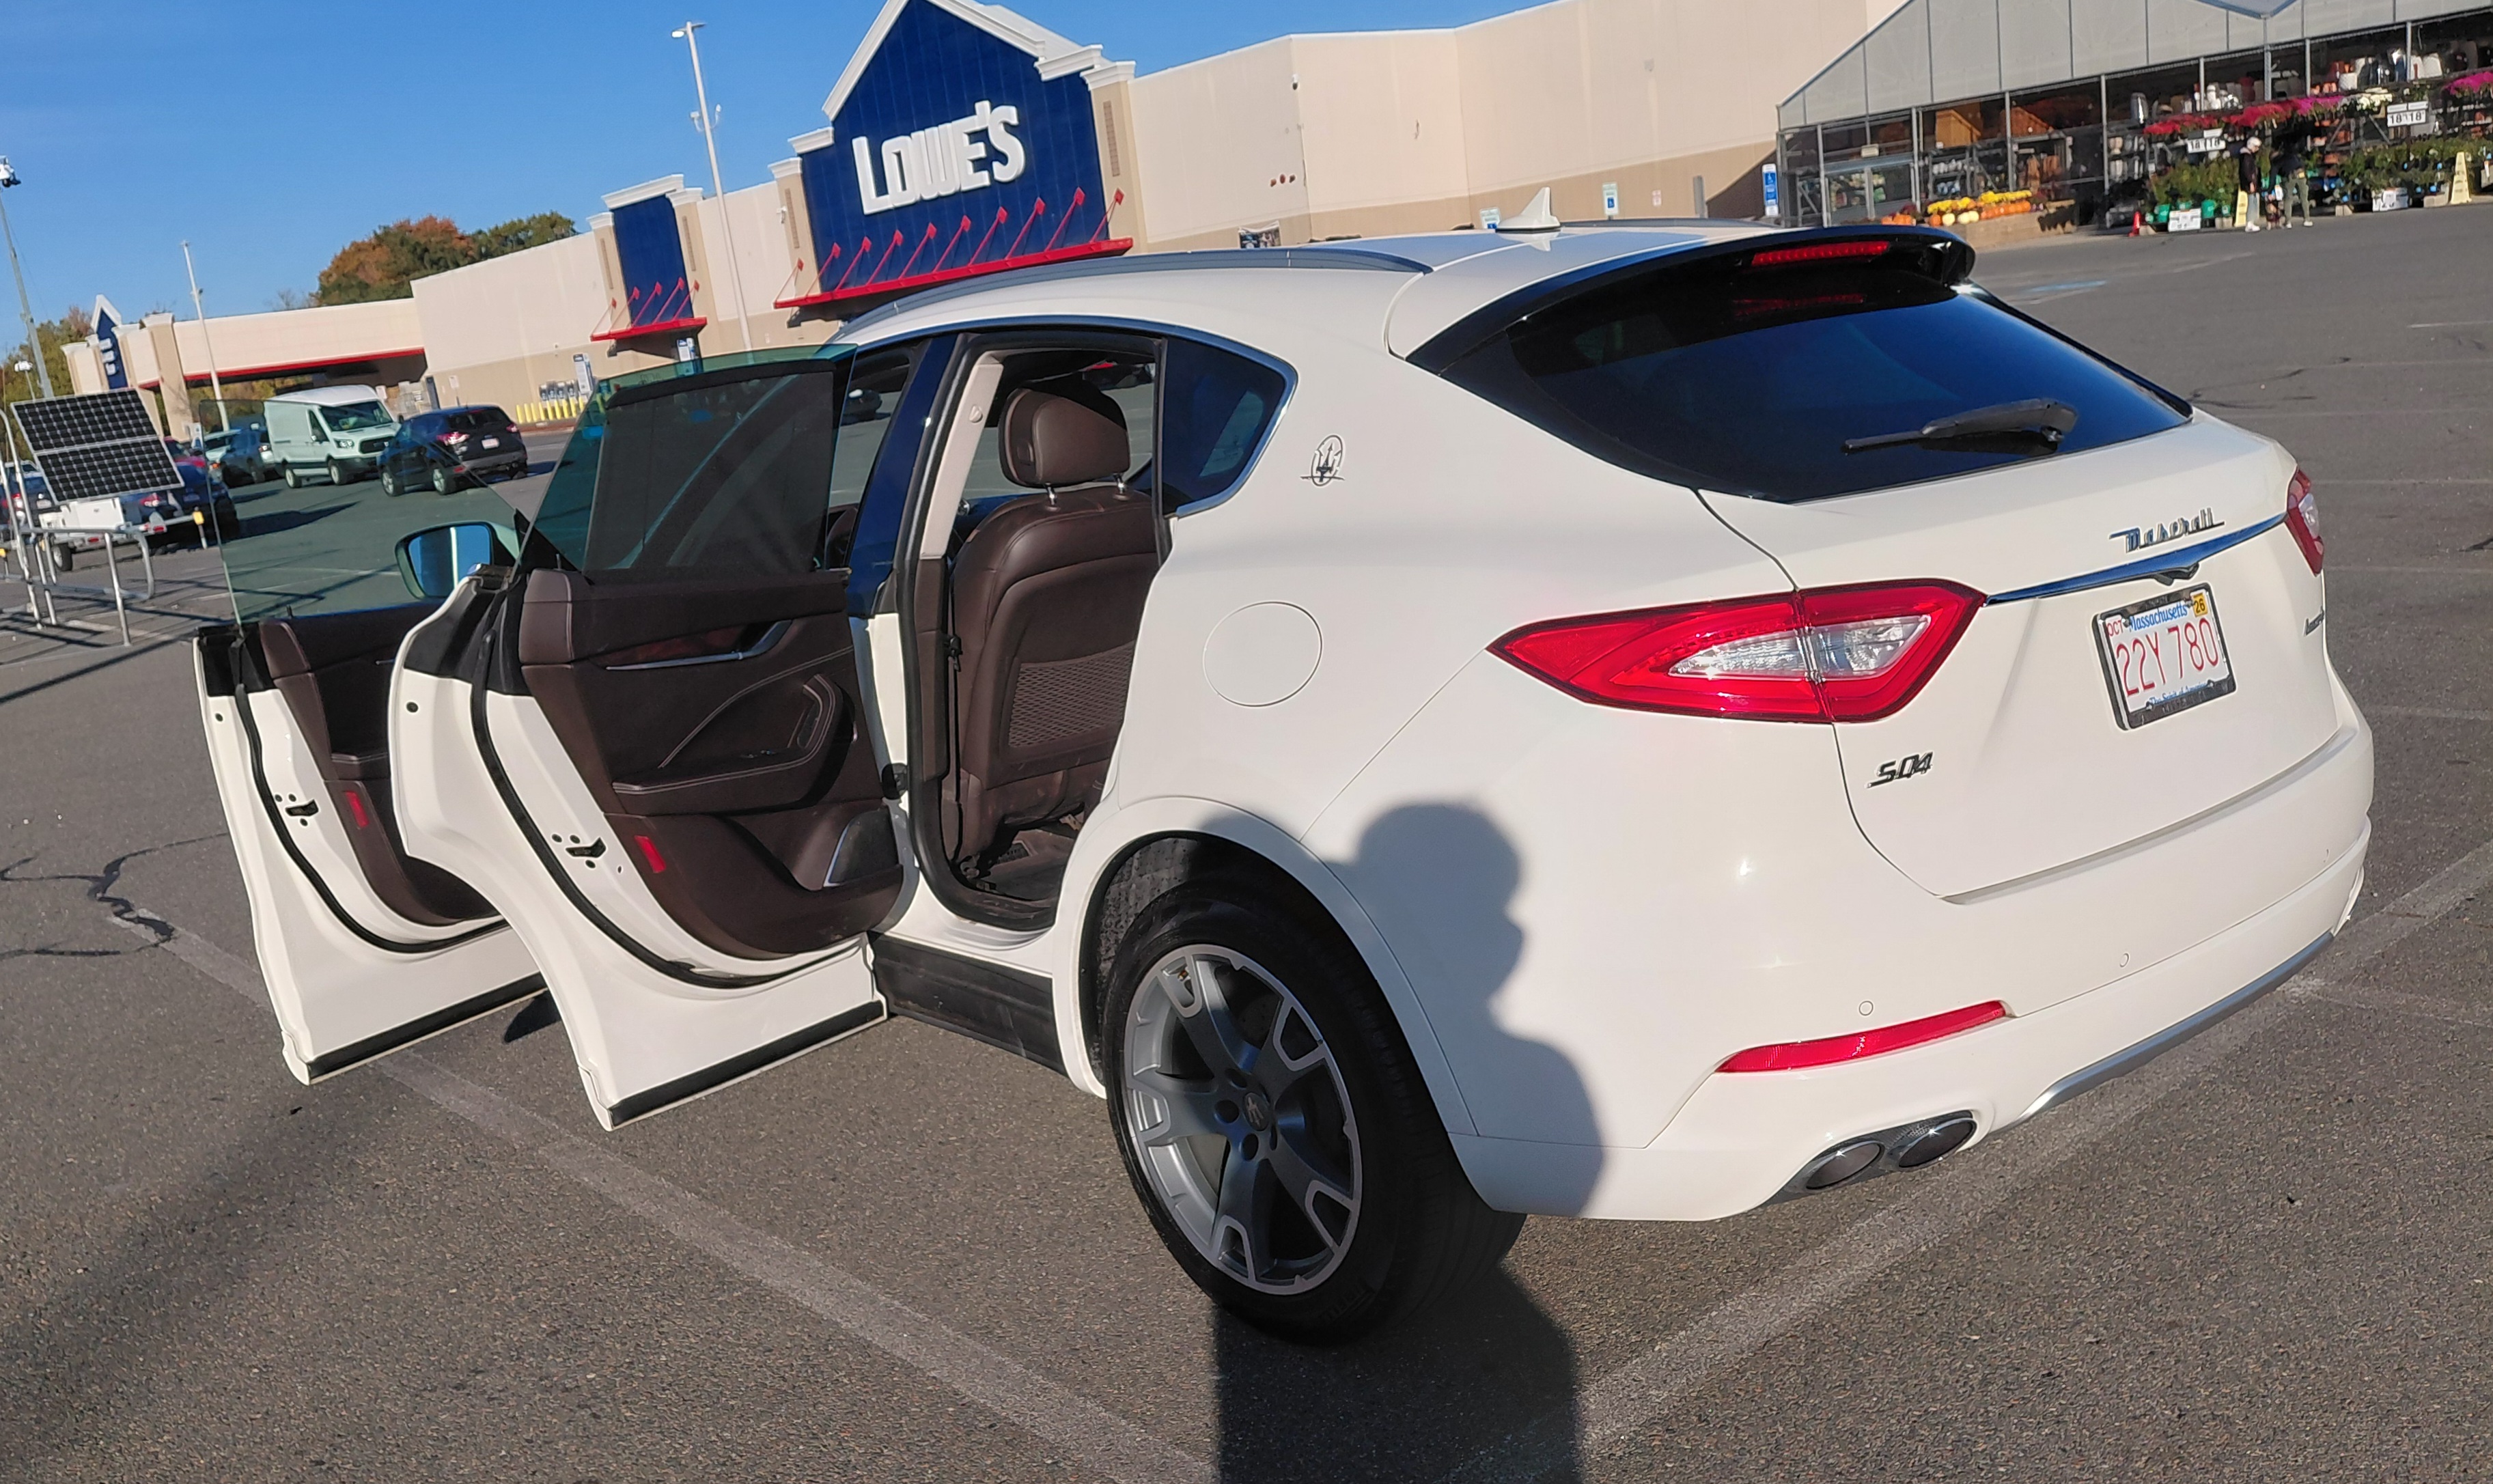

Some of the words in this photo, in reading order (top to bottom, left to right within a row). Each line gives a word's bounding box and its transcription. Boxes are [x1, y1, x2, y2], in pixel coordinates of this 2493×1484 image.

[852, 100, 1025, 215] LOWE'S
[2129, 601, 2188, 631] Massachusetts
[2195, 598, 2205, 613] 26
[2107, 619, 2123, 636] OCT
[2116, 632, 2166, 697] 22Y
[2167, 617, 2219, 678] 780
